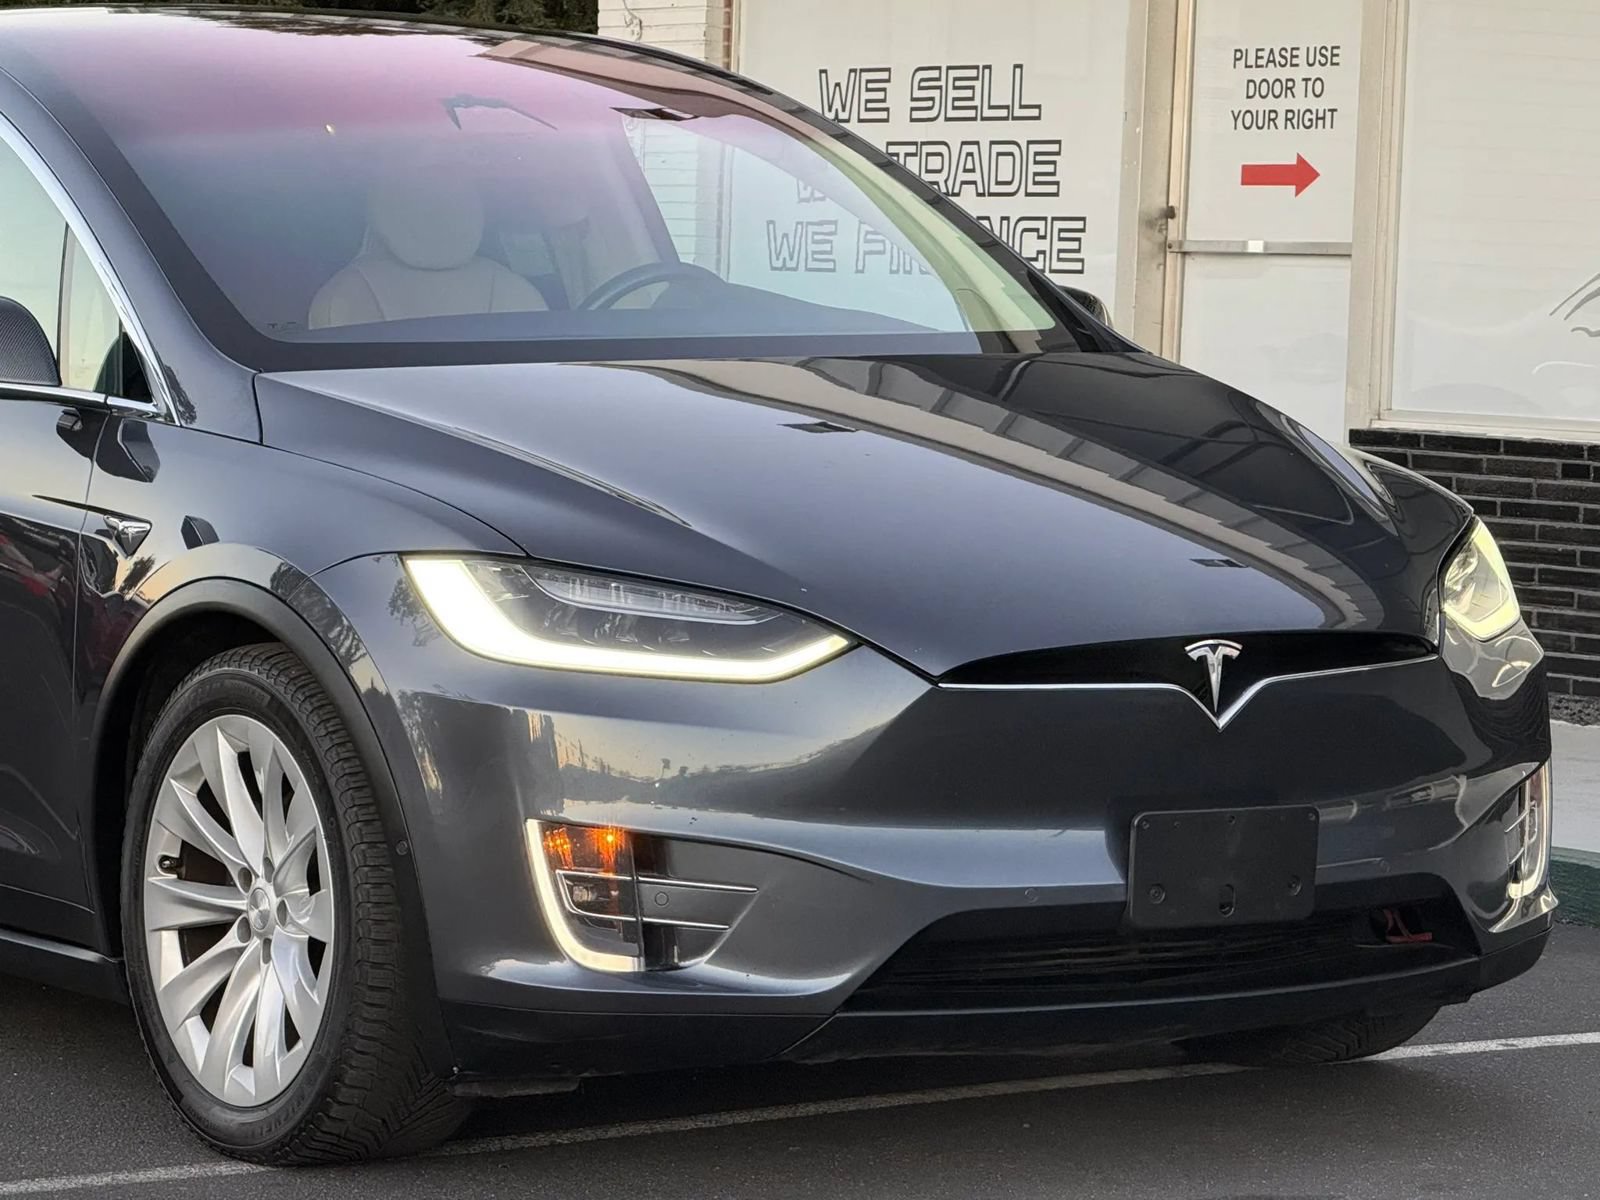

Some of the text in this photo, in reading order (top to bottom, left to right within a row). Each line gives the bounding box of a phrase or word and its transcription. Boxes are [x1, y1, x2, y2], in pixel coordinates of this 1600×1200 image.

[1233, 45, 1341, 69] PLEASE USE
[819, 63, 1042, 123] WE SELL
[1245, 77, 1325, 99] DOOR TO
[1231, 108, 1338, 130] YOUR RIGHT
[766, 219, 838, 273] WE
